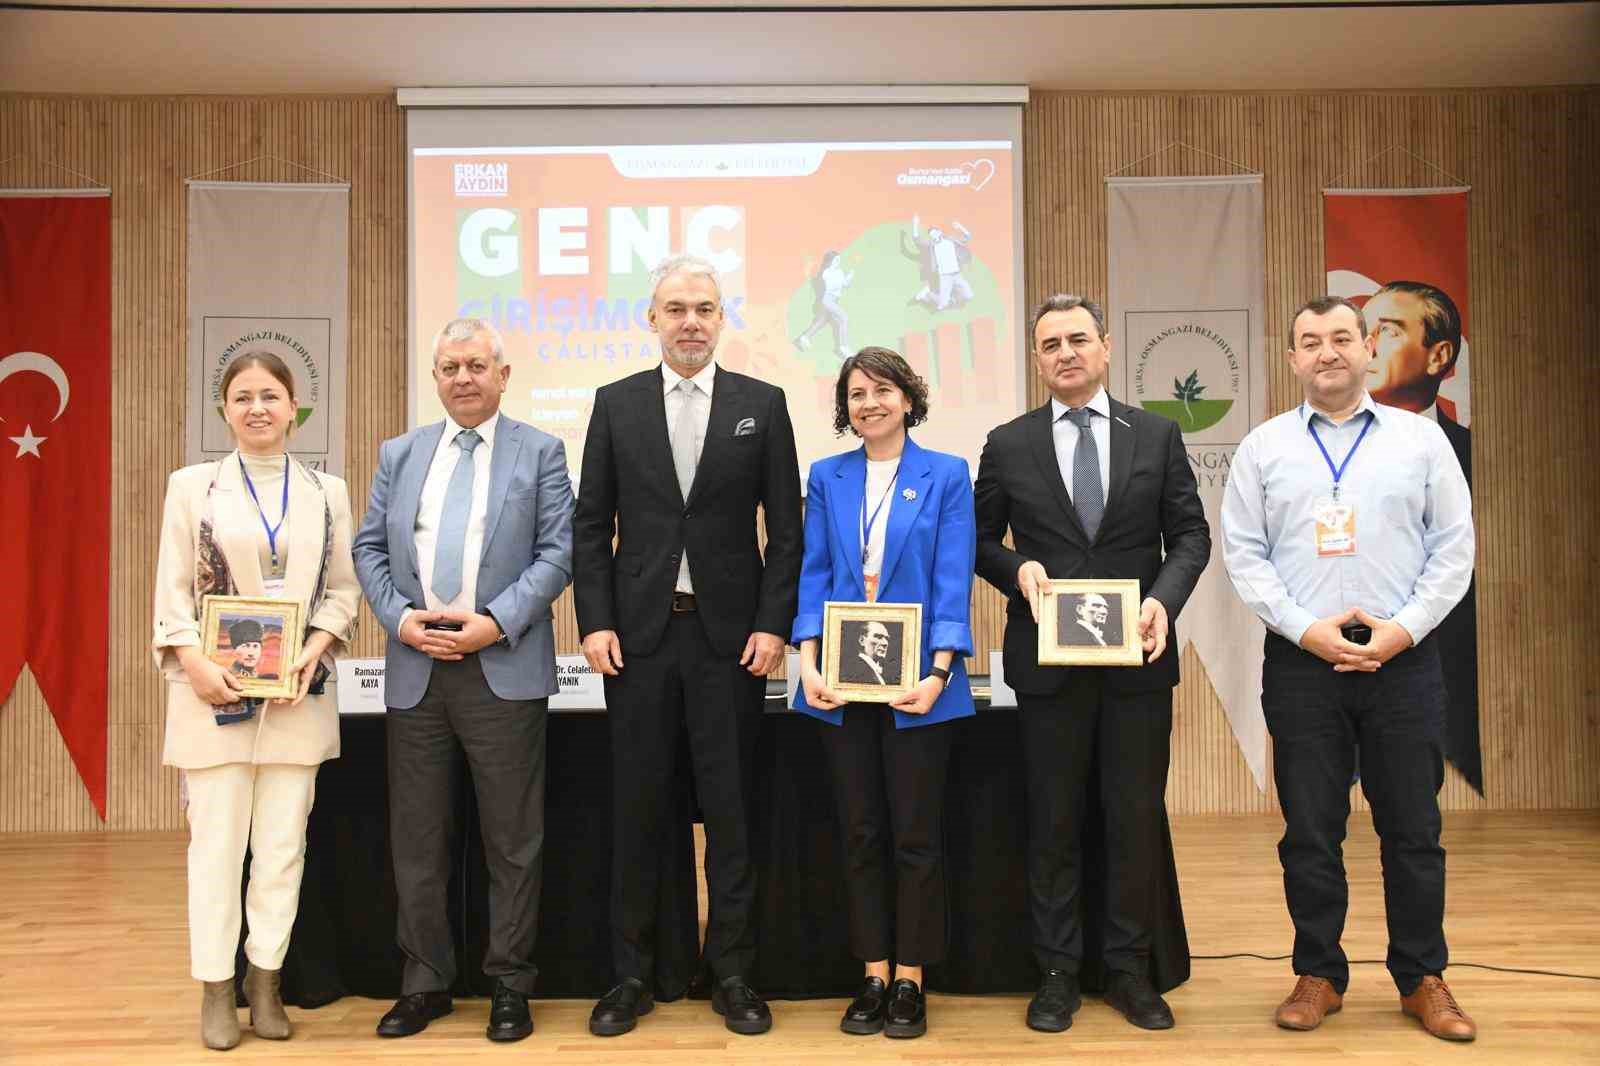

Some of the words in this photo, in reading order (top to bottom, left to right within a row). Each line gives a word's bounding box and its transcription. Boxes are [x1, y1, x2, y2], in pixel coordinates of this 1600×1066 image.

[455, 163, 506, 177] ERKAN
[360, 678, 379, 689] KAYA
[558, 676, 579, 687] YANIK
